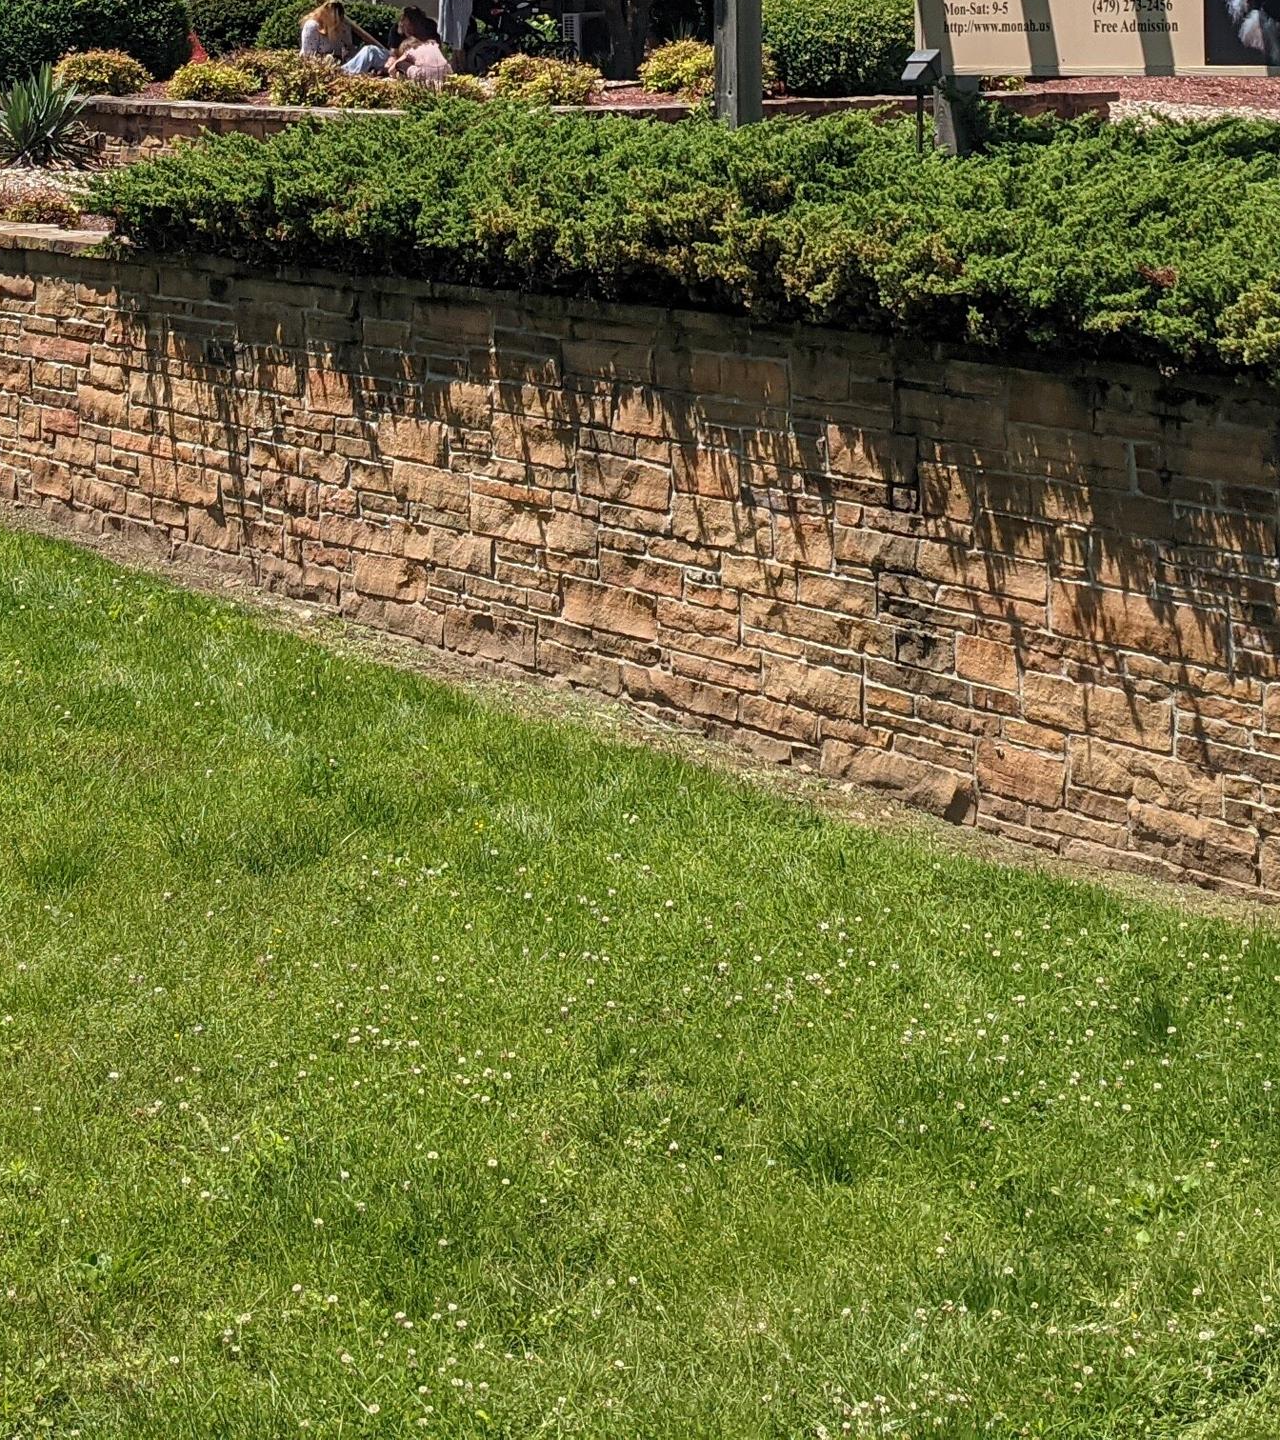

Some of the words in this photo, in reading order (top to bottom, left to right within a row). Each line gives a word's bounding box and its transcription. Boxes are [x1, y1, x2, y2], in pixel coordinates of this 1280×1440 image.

[944, 2, 990, 16] Mon-Sat:
[992, 1, 1009, 15] 9-5
[943, 19, 1050, 36] http://www.monah.us
[1094, 20, 1118, 33] Free
[1120, 18, 1179, 33] Admission
